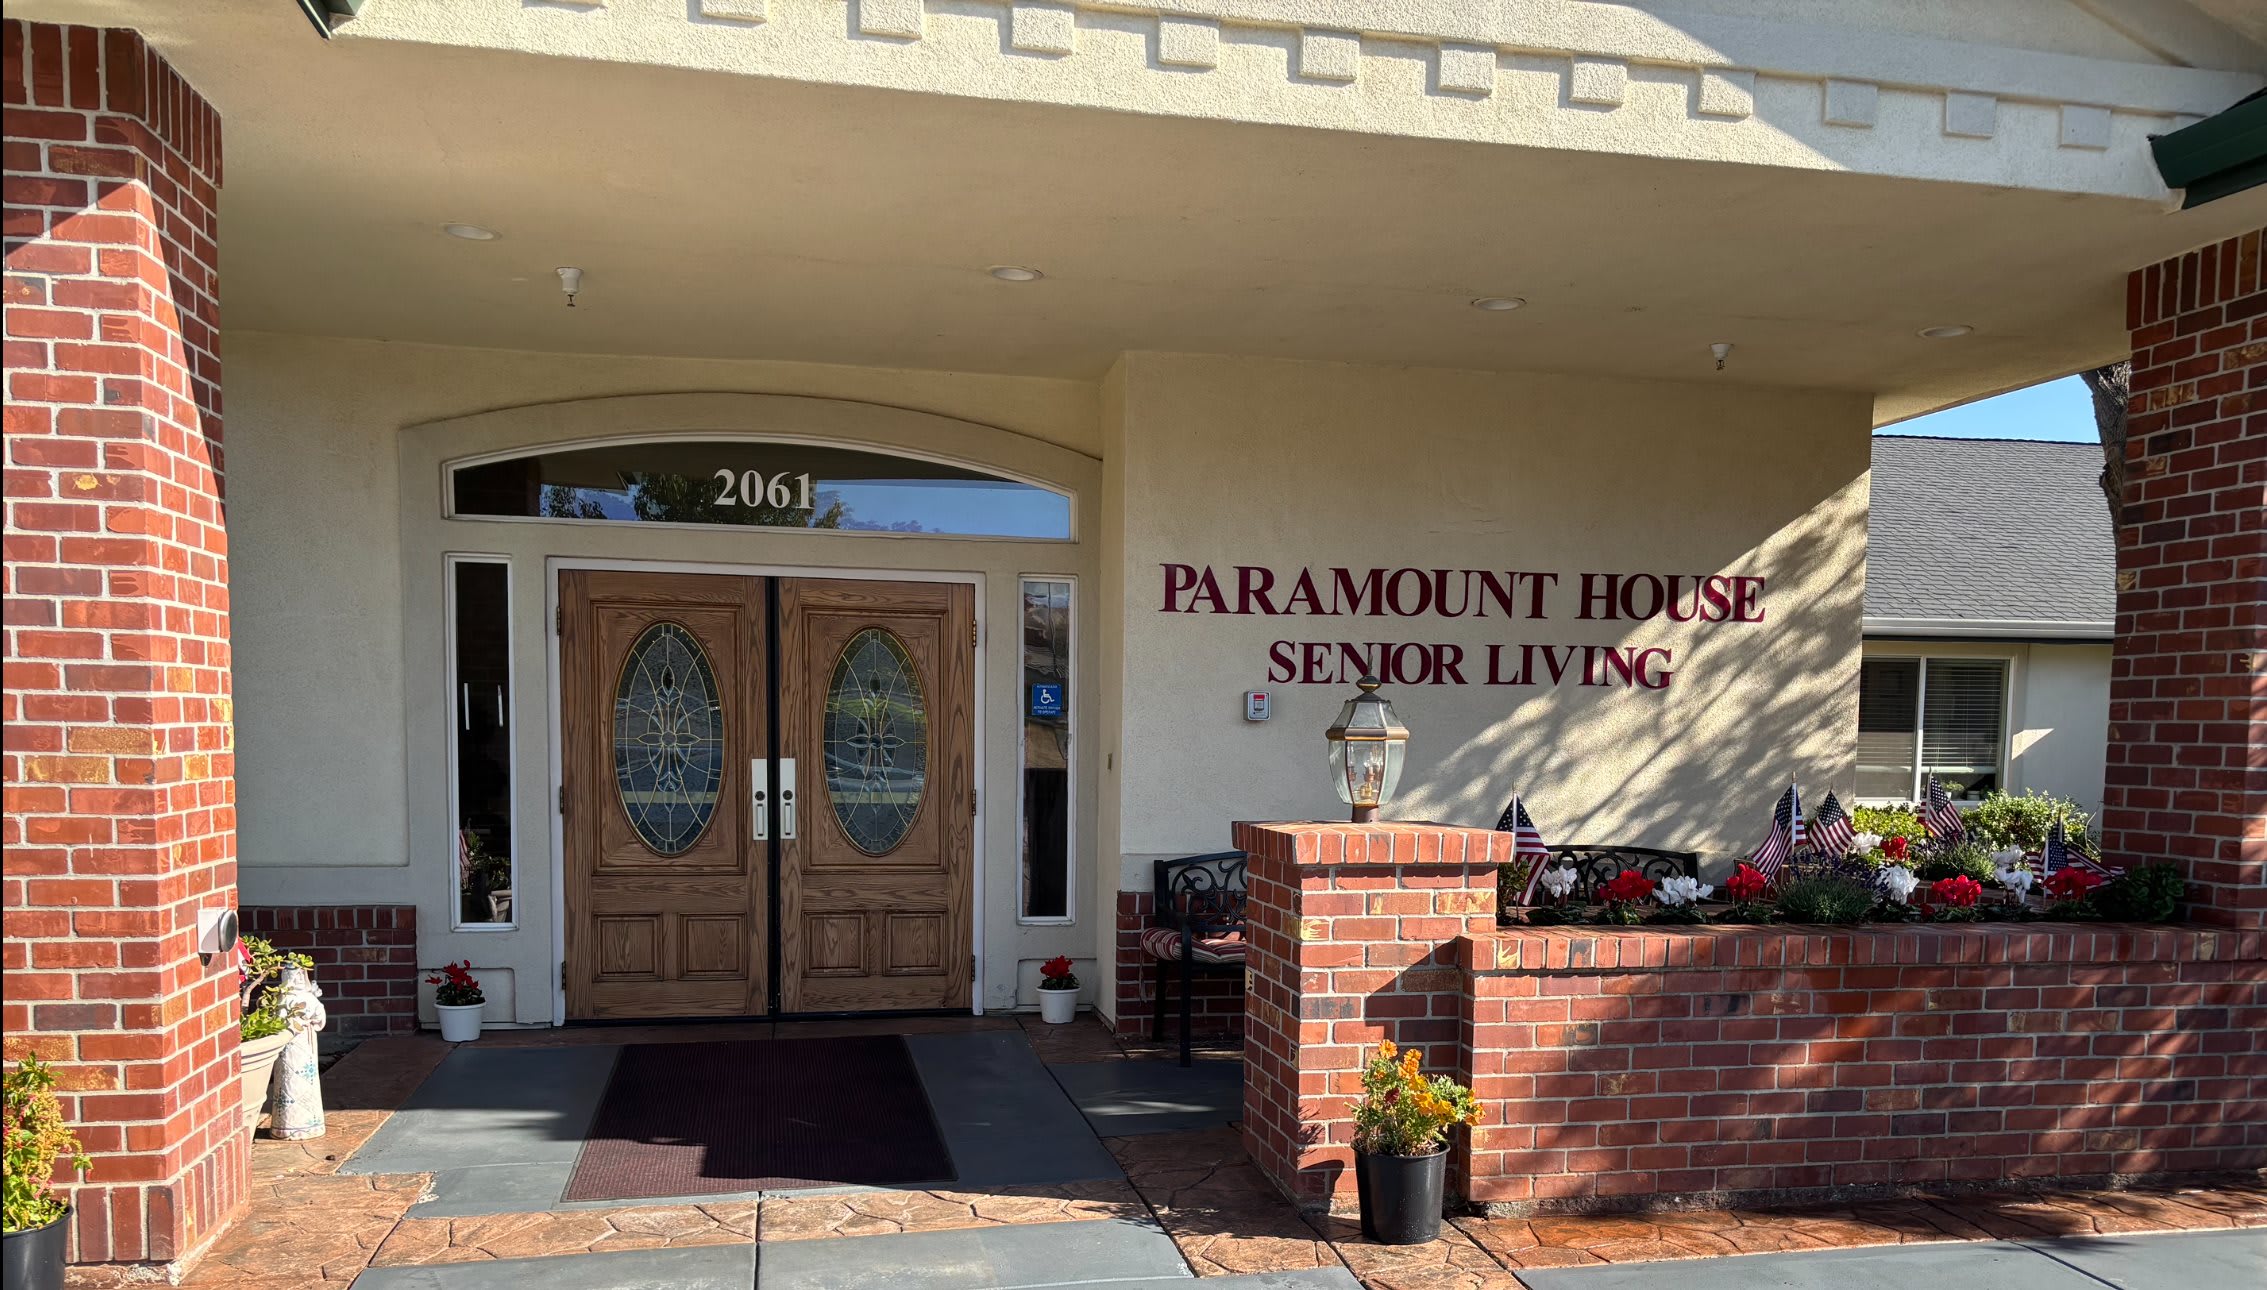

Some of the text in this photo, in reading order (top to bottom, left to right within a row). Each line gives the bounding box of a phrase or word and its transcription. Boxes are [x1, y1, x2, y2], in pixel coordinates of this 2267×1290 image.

[713, 468, 815, 509] 2061
[1159, 563, 1767, 624] PARAMOUNT HOUSE
[1268, 640, 1673, 690] SENIOR LIVING
